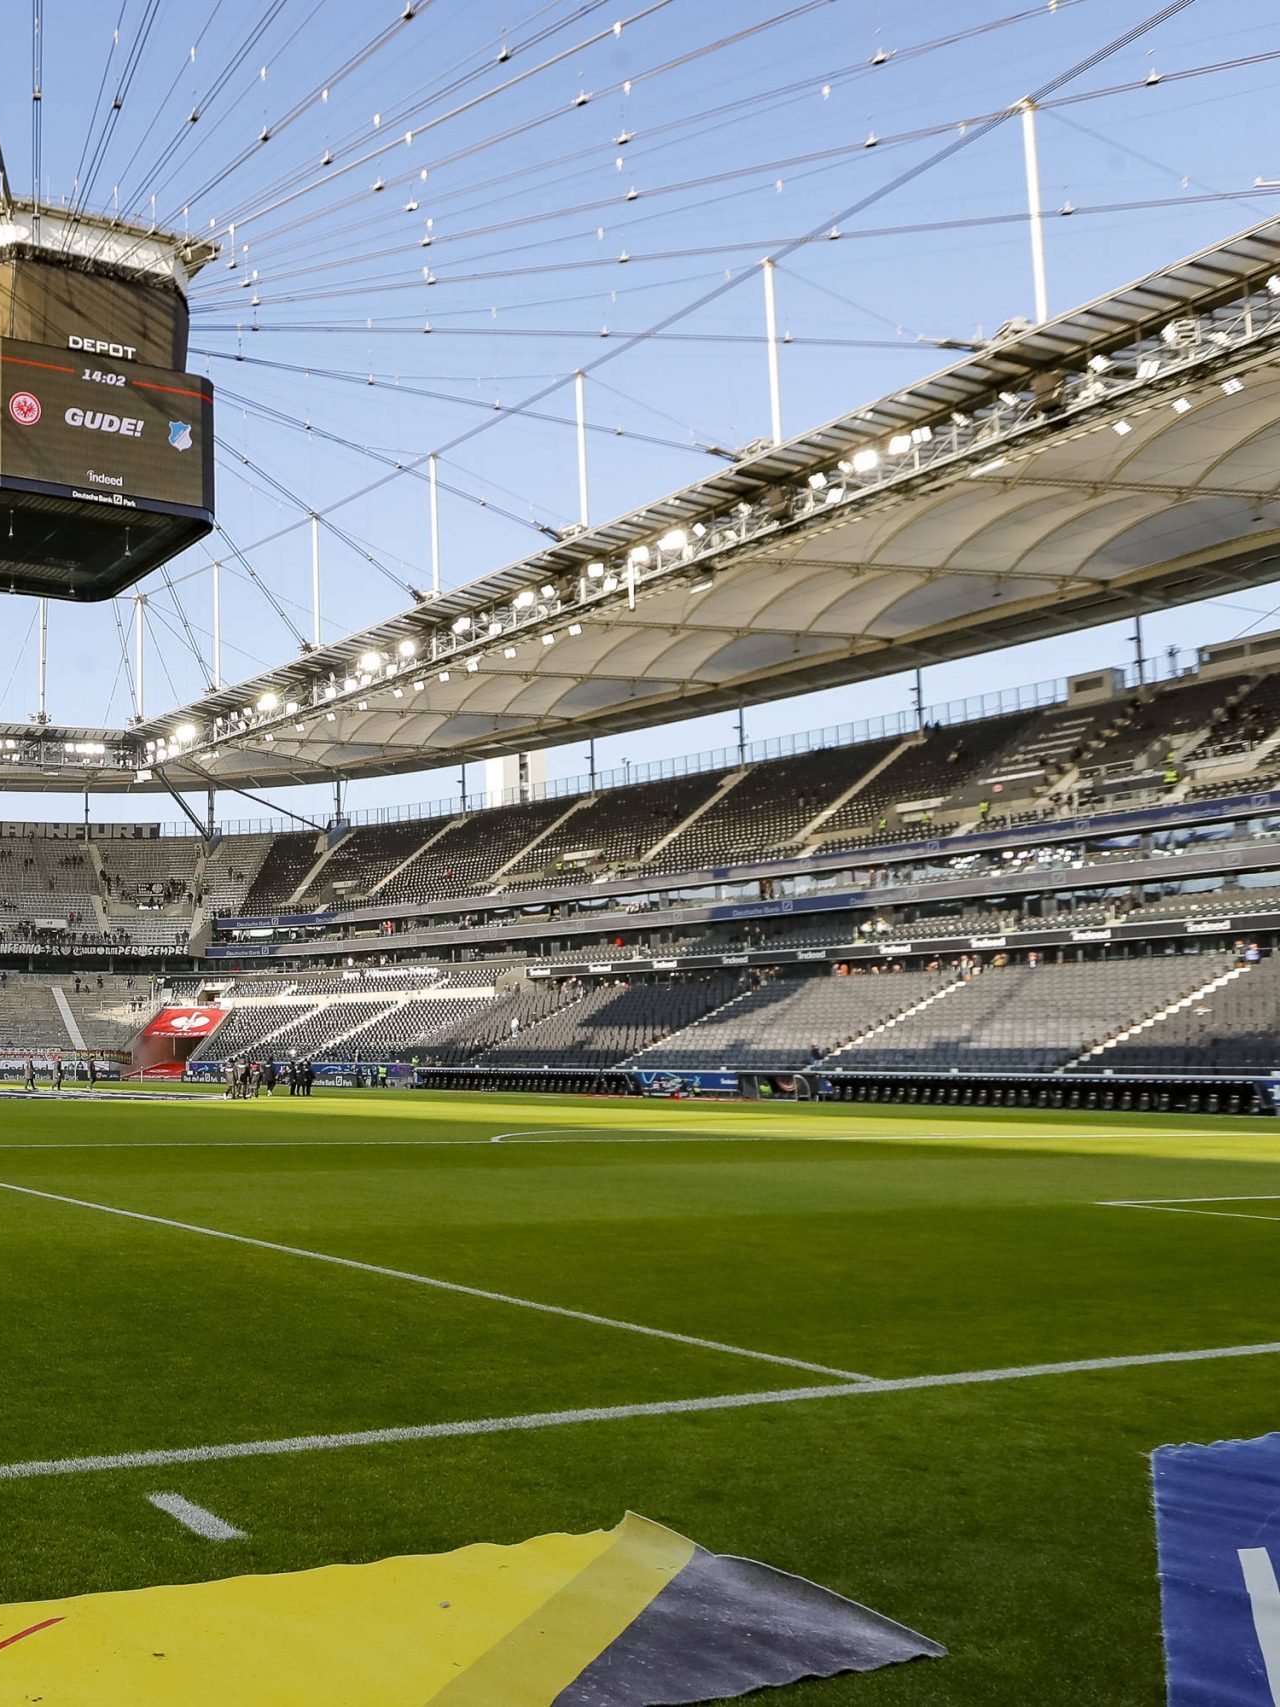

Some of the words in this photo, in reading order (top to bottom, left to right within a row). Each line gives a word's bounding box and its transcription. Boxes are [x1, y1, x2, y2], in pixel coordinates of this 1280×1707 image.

[69, 336, 136, 360] DEPOT
[82, 369, 126, 387] 14:02
[65, 407, 145, 437] GUDE!
[87, 470, 123, 486] indeed
[72, 490, 98, 501] Deutsche
[99, 494, 113, 503] Bank
[123, 499, 137, 507] Park
[722, 955, 748, 964] indeed
[797, 951, 826, 960] indeed
